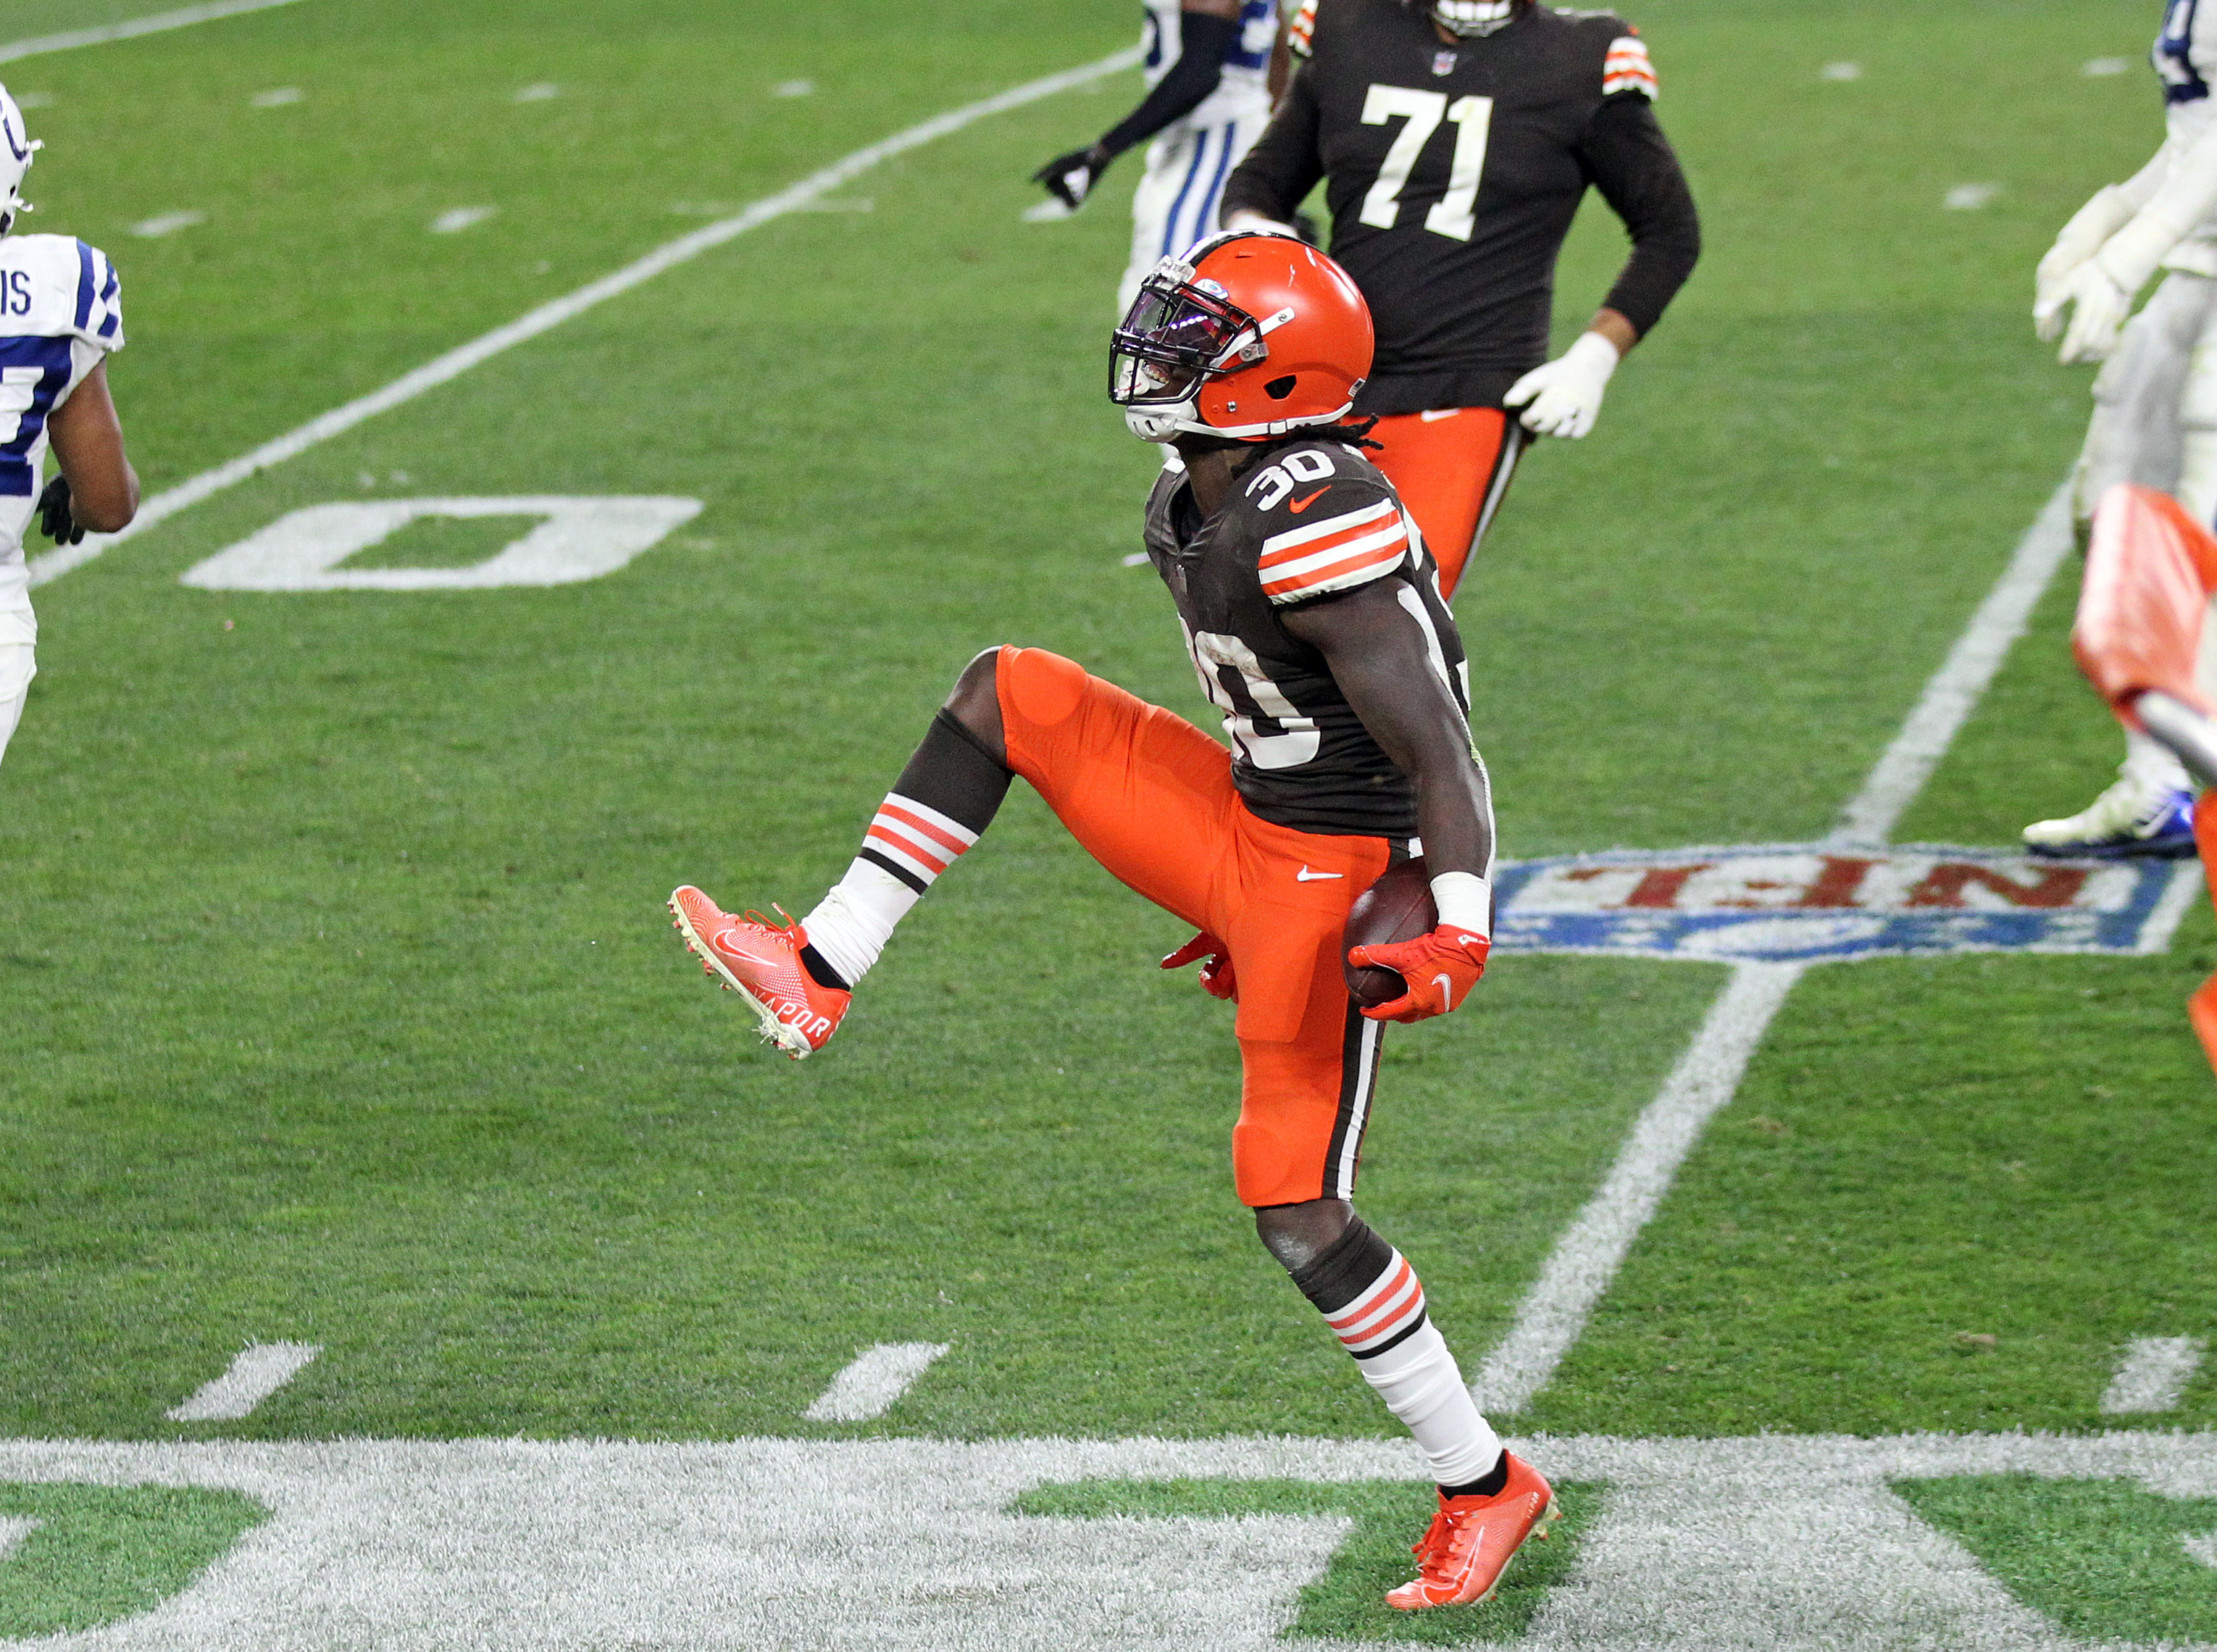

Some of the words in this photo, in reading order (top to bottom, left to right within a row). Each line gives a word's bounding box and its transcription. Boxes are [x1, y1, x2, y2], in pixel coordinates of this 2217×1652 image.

[1359, 83, 1493, 241] 71
[1245, 450, 1336, 512] 30
[1559, 855, 2094, 909] NFL
[753, 988, 831, 1038] VAPOR
